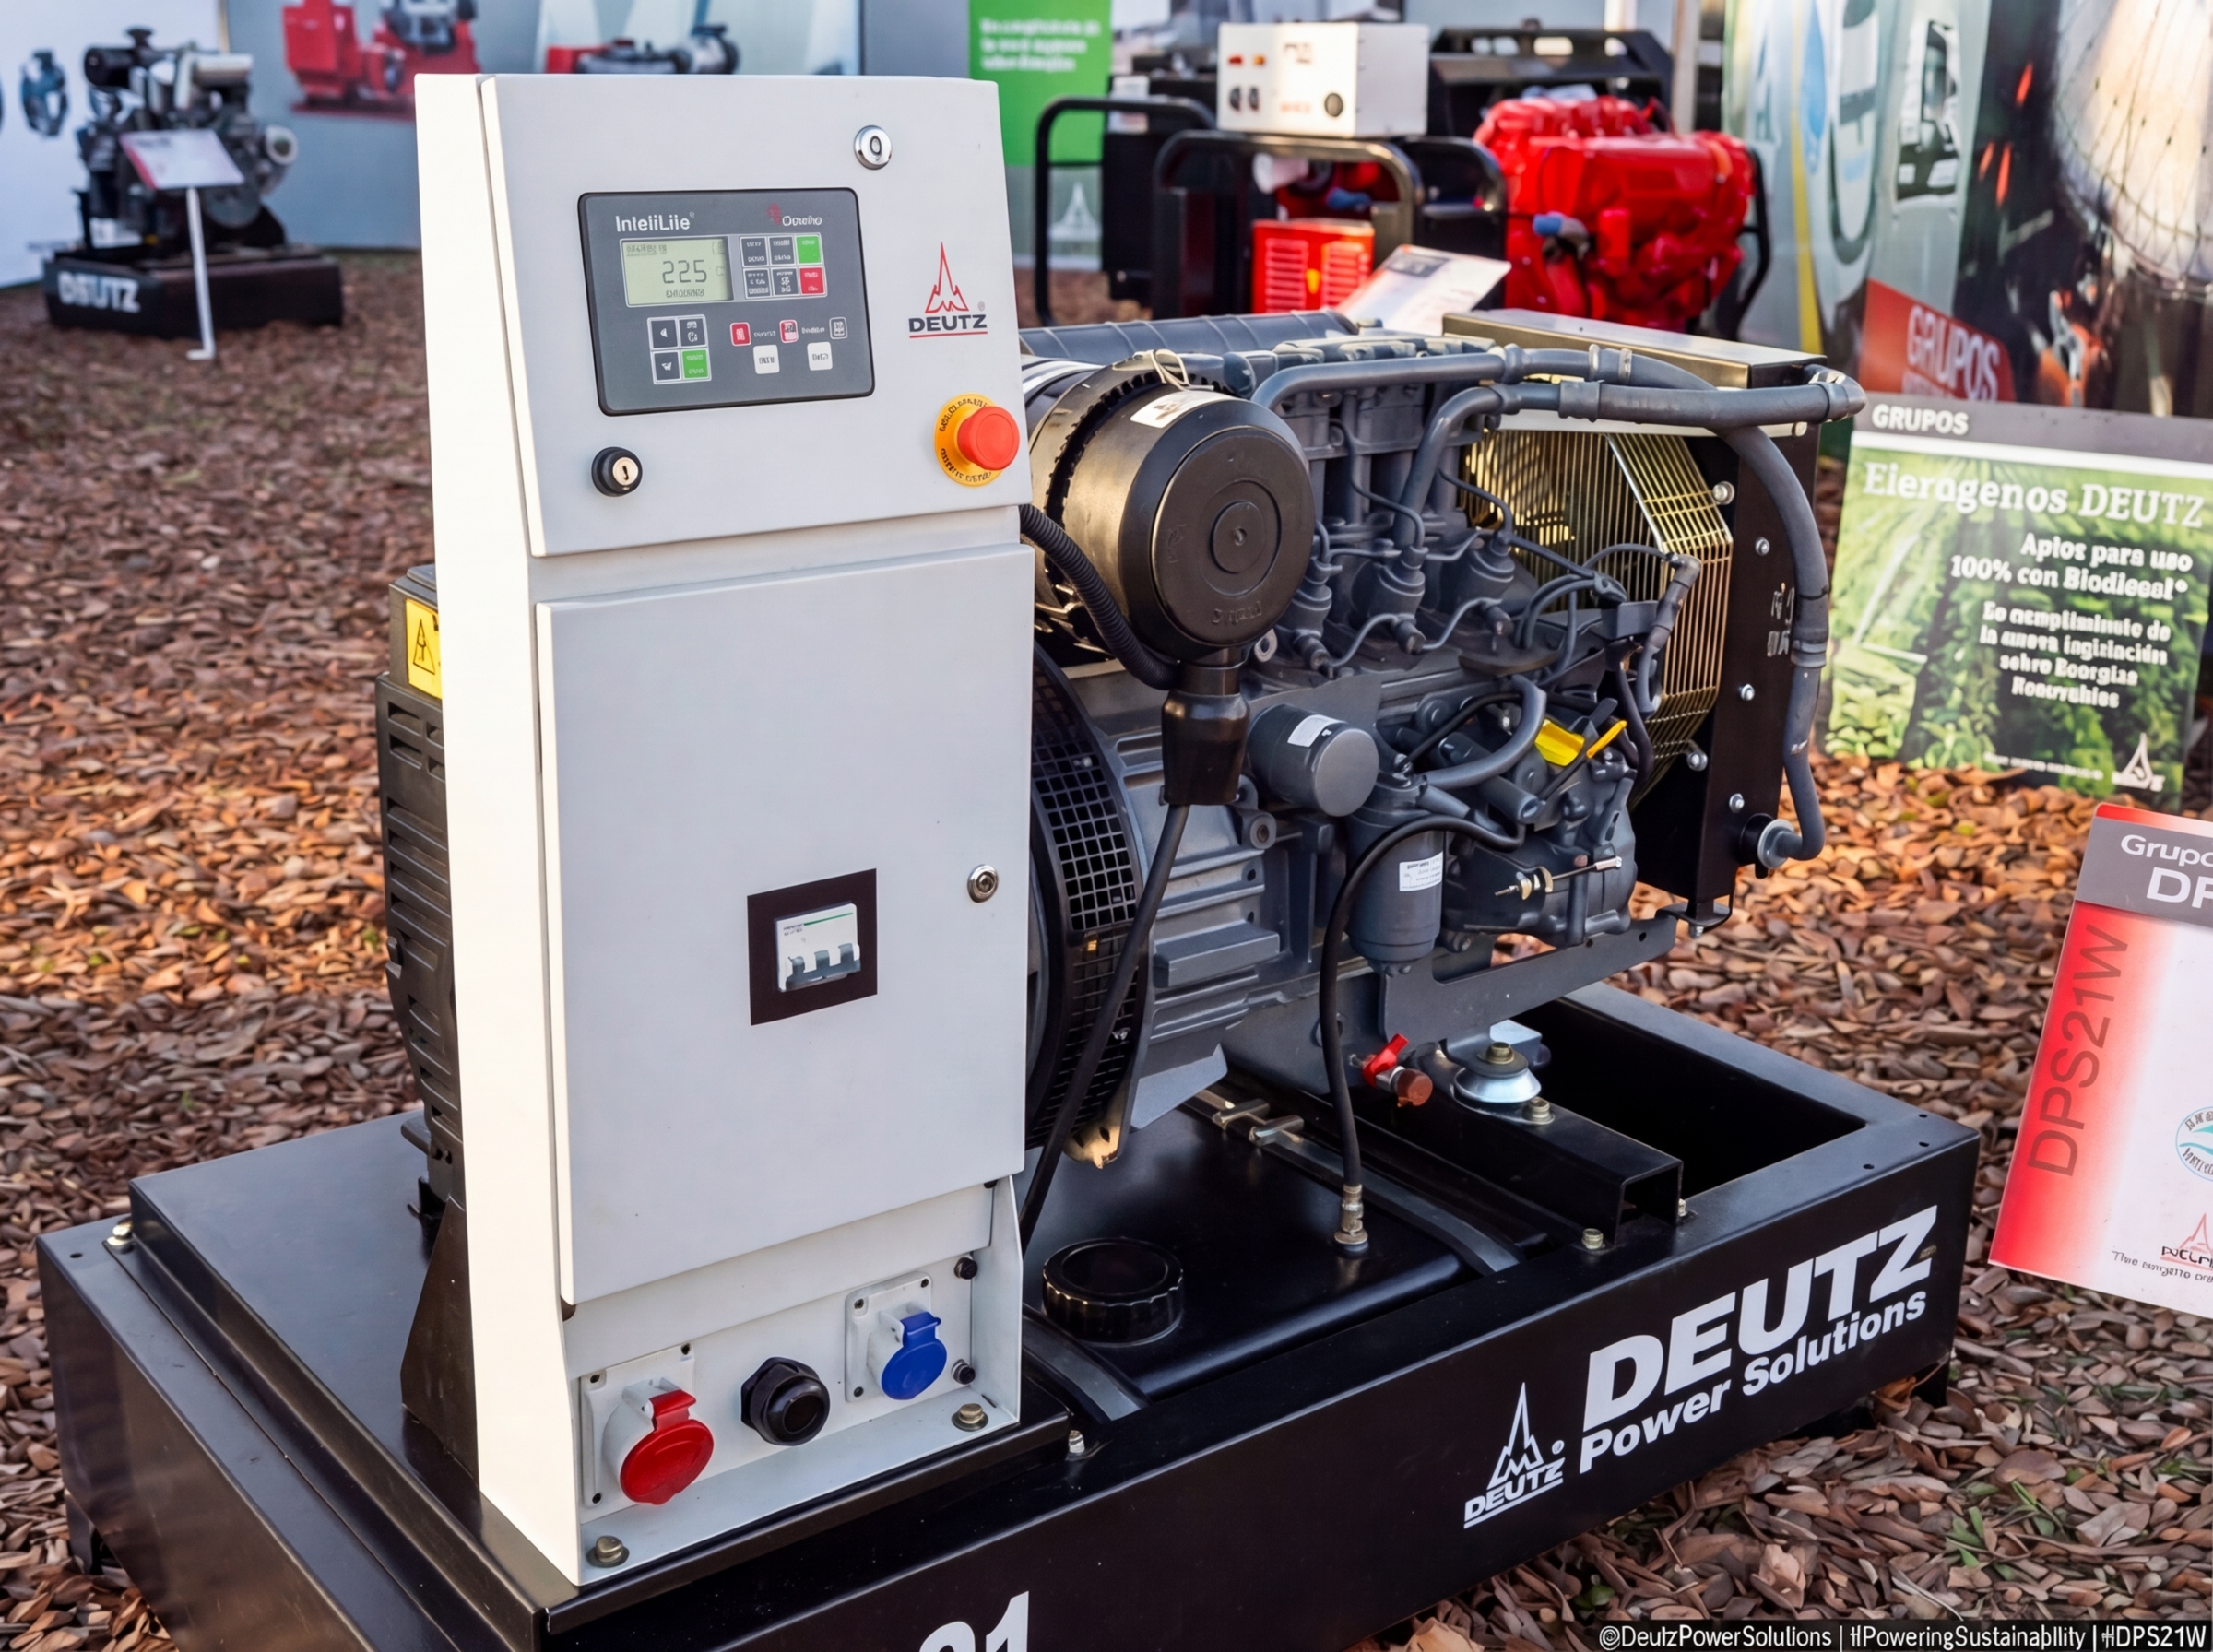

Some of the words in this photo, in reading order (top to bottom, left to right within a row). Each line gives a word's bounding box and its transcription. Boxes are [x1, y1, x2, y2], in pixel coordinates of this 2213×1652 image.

[662, 259, 707, 284] 225
[908, 313, 988, 333] DEUTZ
[1871, 403, 1970, 437] GRUPOS
[2078, 483, 2206, 529] DEUTZ
[1950, 555, 2013, 584] 100%
[2017, 566, 2059, 589] con
[2028, 923, 2129, 1177] DPS21W
[1582, 1204, 1938, 1432] DEUTZ
[1579, 1376, 1731, 1475] Power
[1742, 1290, 1926, 1397] Solutions
[1464, 1457, 1566, 1523] DEUTZ
